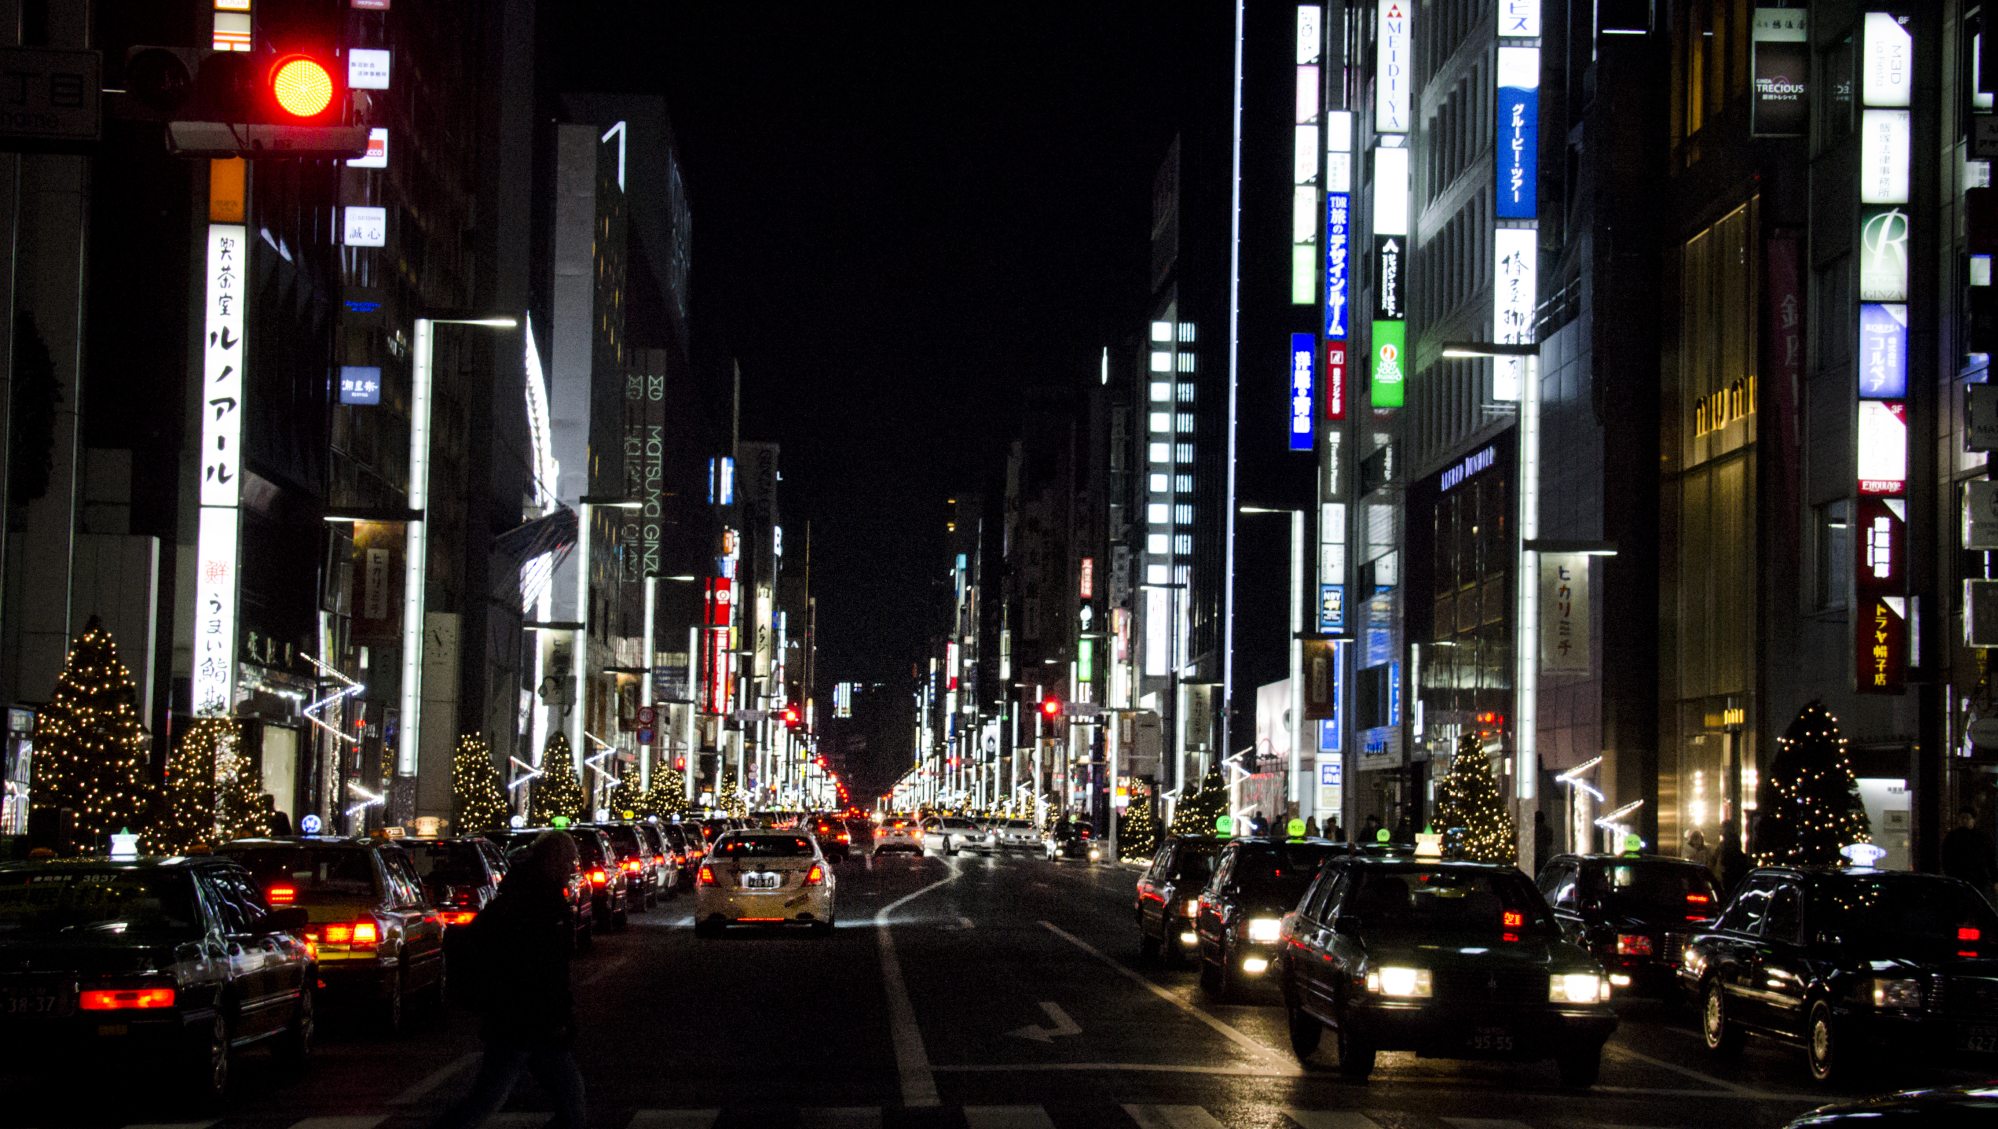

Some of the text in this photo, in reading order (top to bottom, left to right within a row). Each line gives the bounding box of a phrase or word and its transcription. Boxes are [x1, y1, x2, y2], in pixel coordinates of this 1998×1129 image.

[1756, 84, 1805, 94] TRECIOUS
[1557, 565, 1572, 657] ヒカリミチ
[1873, 603, 1888, 686] トラヤ帽子店
